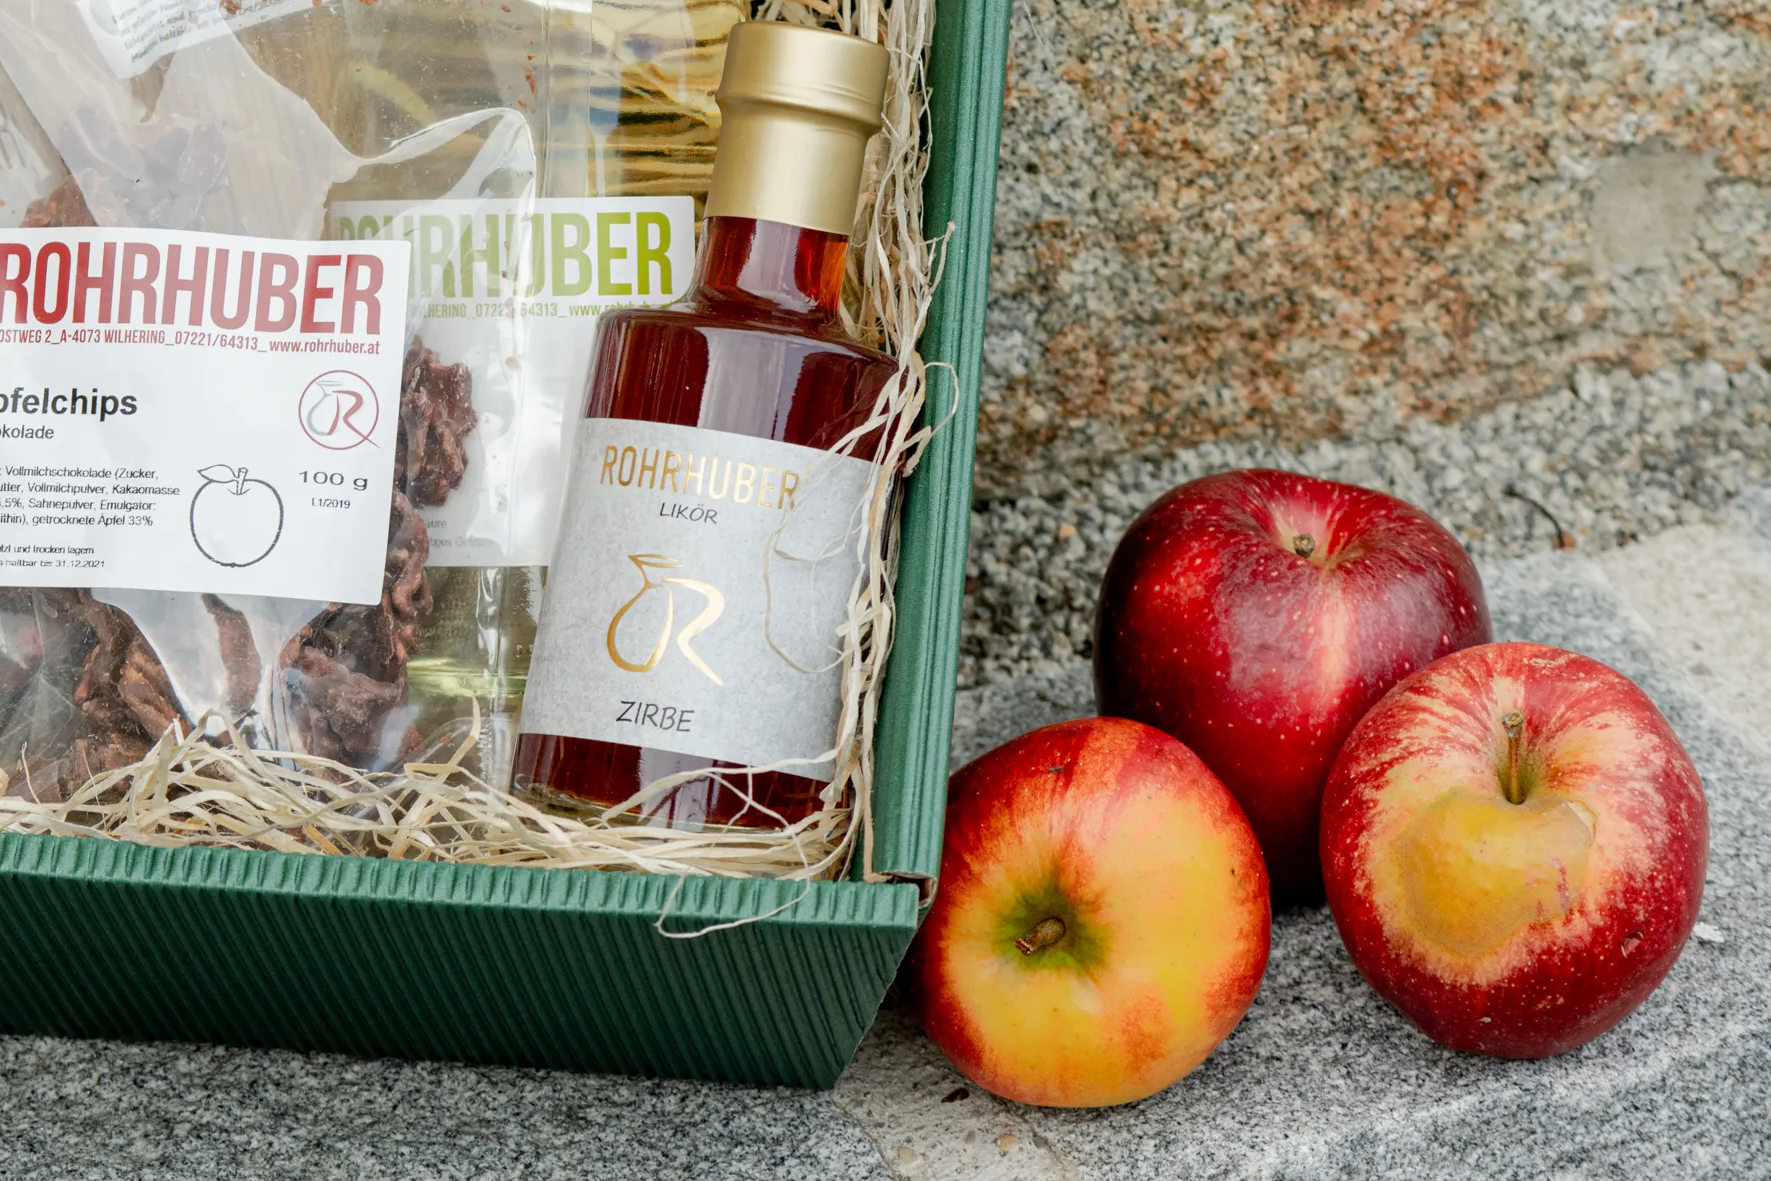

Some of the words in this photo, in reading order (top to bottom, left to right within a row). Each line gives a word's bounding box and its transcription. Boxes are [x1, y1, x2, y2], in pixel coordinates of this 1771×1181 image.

[5, 466, 112, 478] Vollmilchschokolade
[114, 467, 159, 480] (Zucker,
[600, 444, 801, 511] ROHRHUBER
[299, 471, 345, 486] 100
[353, 477, 368, 491] g
[28, 482, 109, 495] Vollmilchpulver,
[112, 483, 180, 495] Kakaomasse
[28, 498, 96, 511] Sahnepulver,
[100, 500, 156, 512] Emulgator:
[311, 497, 351, 509] L1/2019
[32, 514, 95, 526] getrocknete
[128, 515, 153, 526] 33%
[659, 502, 717, 524] LIKÖR
[14, 545, 31, 553] und
[34, 545, 66, 554] trocken
[68, 545, 95, 556] lagern
[55, 559, 105, 568] 31.12.2021
[616, 700, 695, 733] ZIRBE
